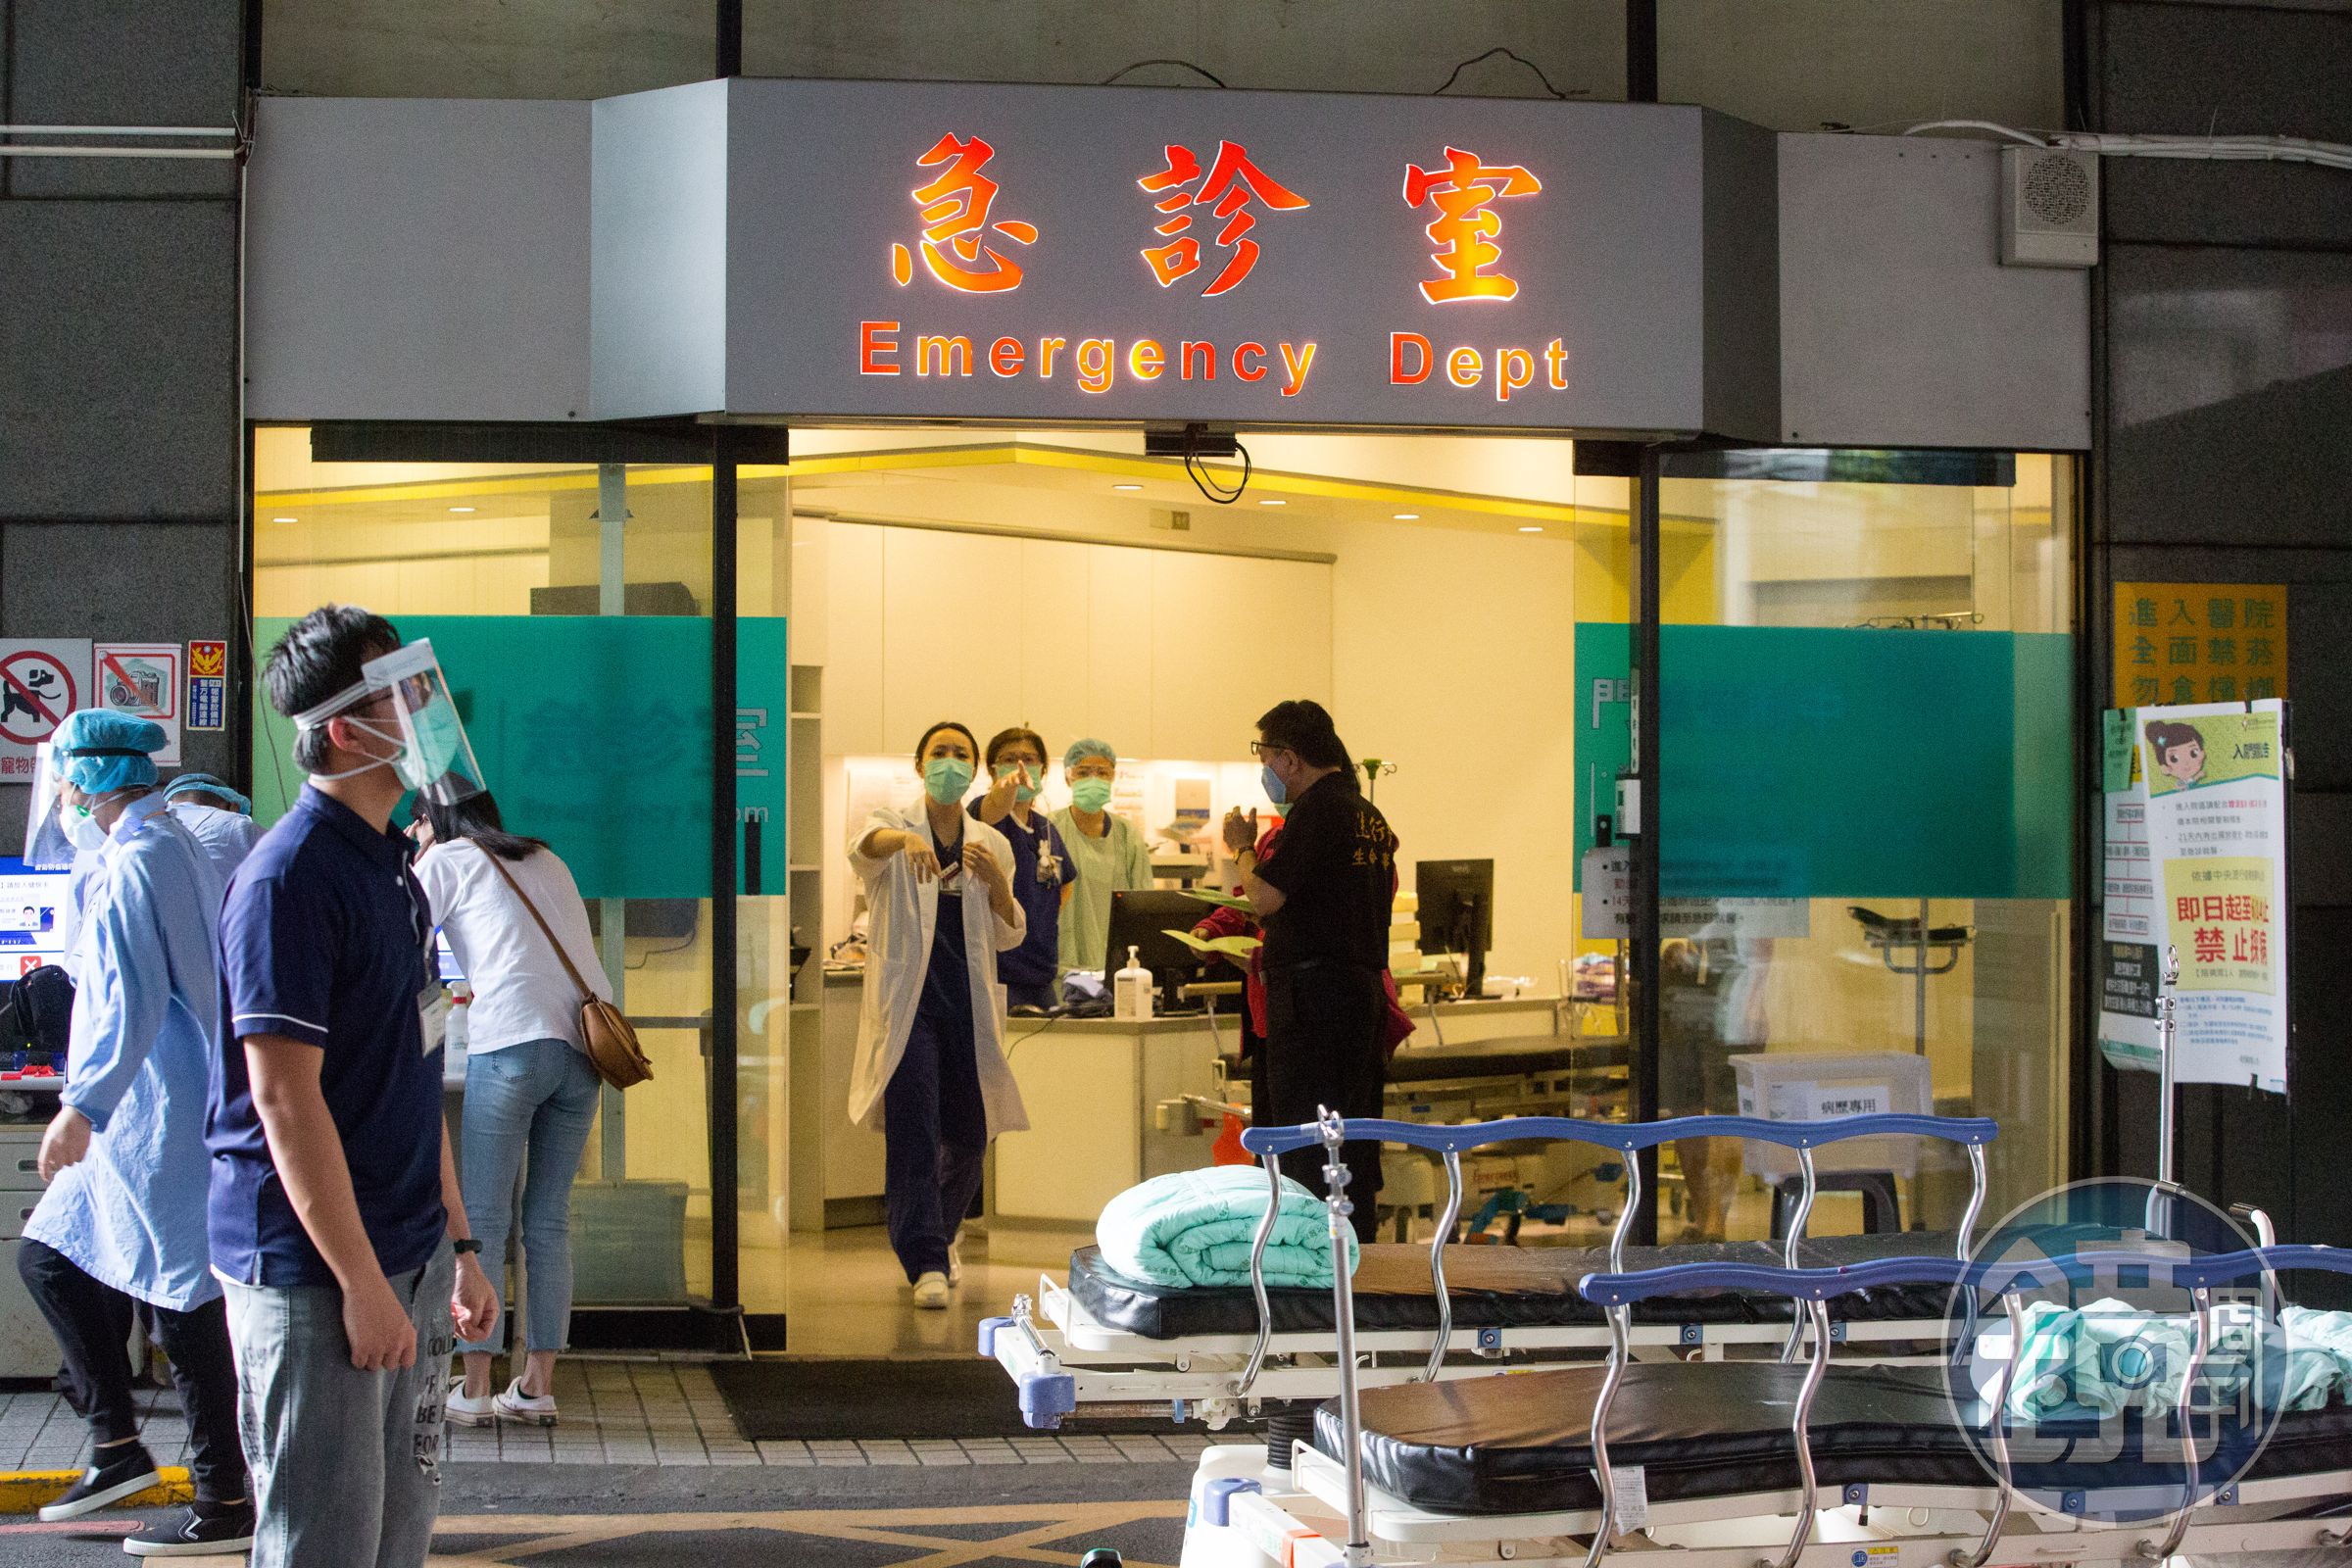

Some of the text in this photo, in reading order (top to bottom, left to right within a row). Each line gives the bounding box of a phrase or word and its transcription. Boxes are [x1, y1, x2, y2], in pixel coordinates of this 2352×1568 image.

[893, 131, 1543, 305] 急診室
[858, 320, 1568, 401] Emergency Dept
[2129, 598, 2275, 628] 進入醫院
